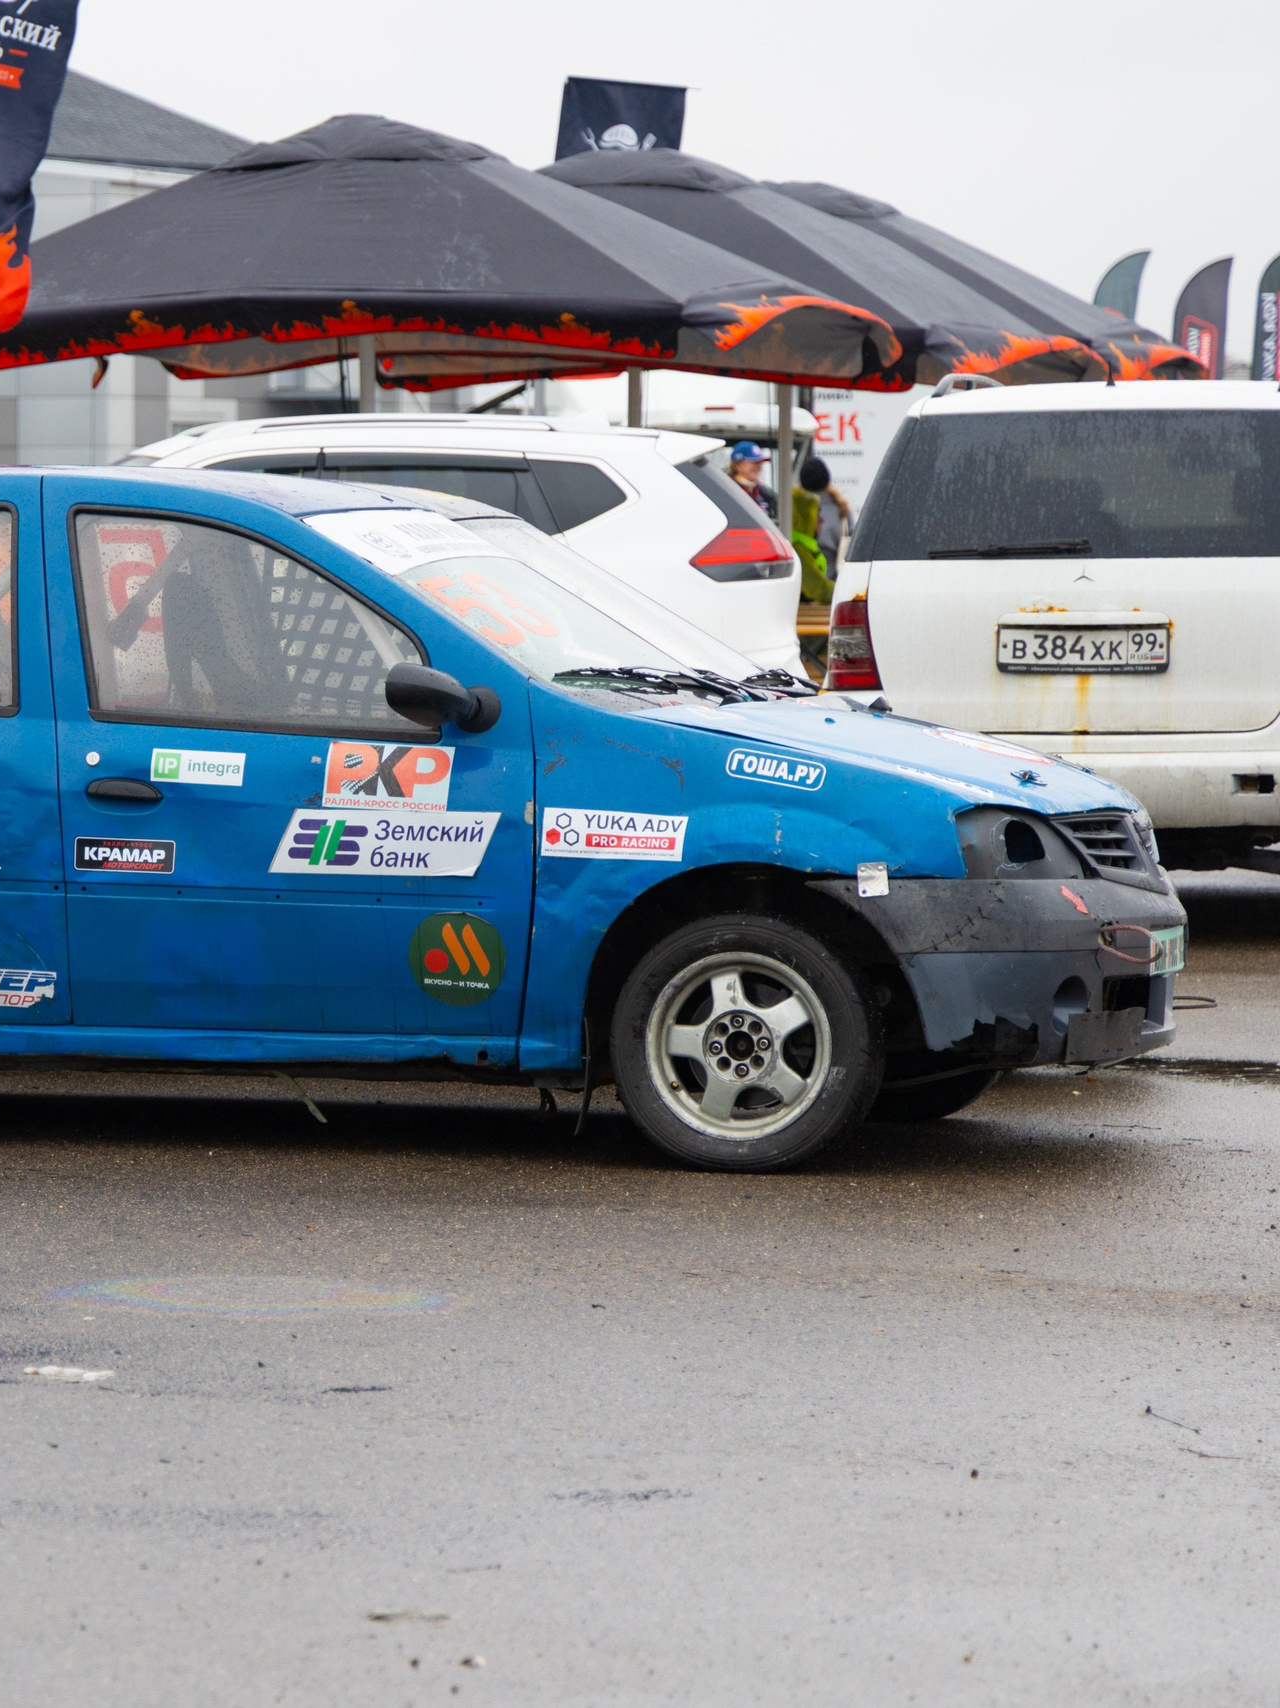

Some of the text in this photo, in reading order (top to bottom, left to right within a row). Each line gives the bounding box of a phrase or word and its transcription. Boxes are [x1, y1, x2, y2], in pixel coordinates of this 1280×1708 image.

[417, 573, 560, 646] 53
[1132, 633, 1158, 652] 99
[1130, 652, 1150, 661] RUS
[158, 757, 240, 777] IP integra
[731, 754, 821, 785] ГОША.РУ
[324, 797, 446, 811] РАЛЛИ-КРОСС РОССИИ
[374, 819, 484, 843] Земский
[584, 813, 684, 833] YUKA ADV
[592, 836, 670, 849] PRO RACING
[84, 846, 166, 863] КРАМАР
[370, 845, 430, 869] банк
[102, 861, 164, 870] МОТОРСПОРТ
[424, 978, 452, 986] ВКУСНО
